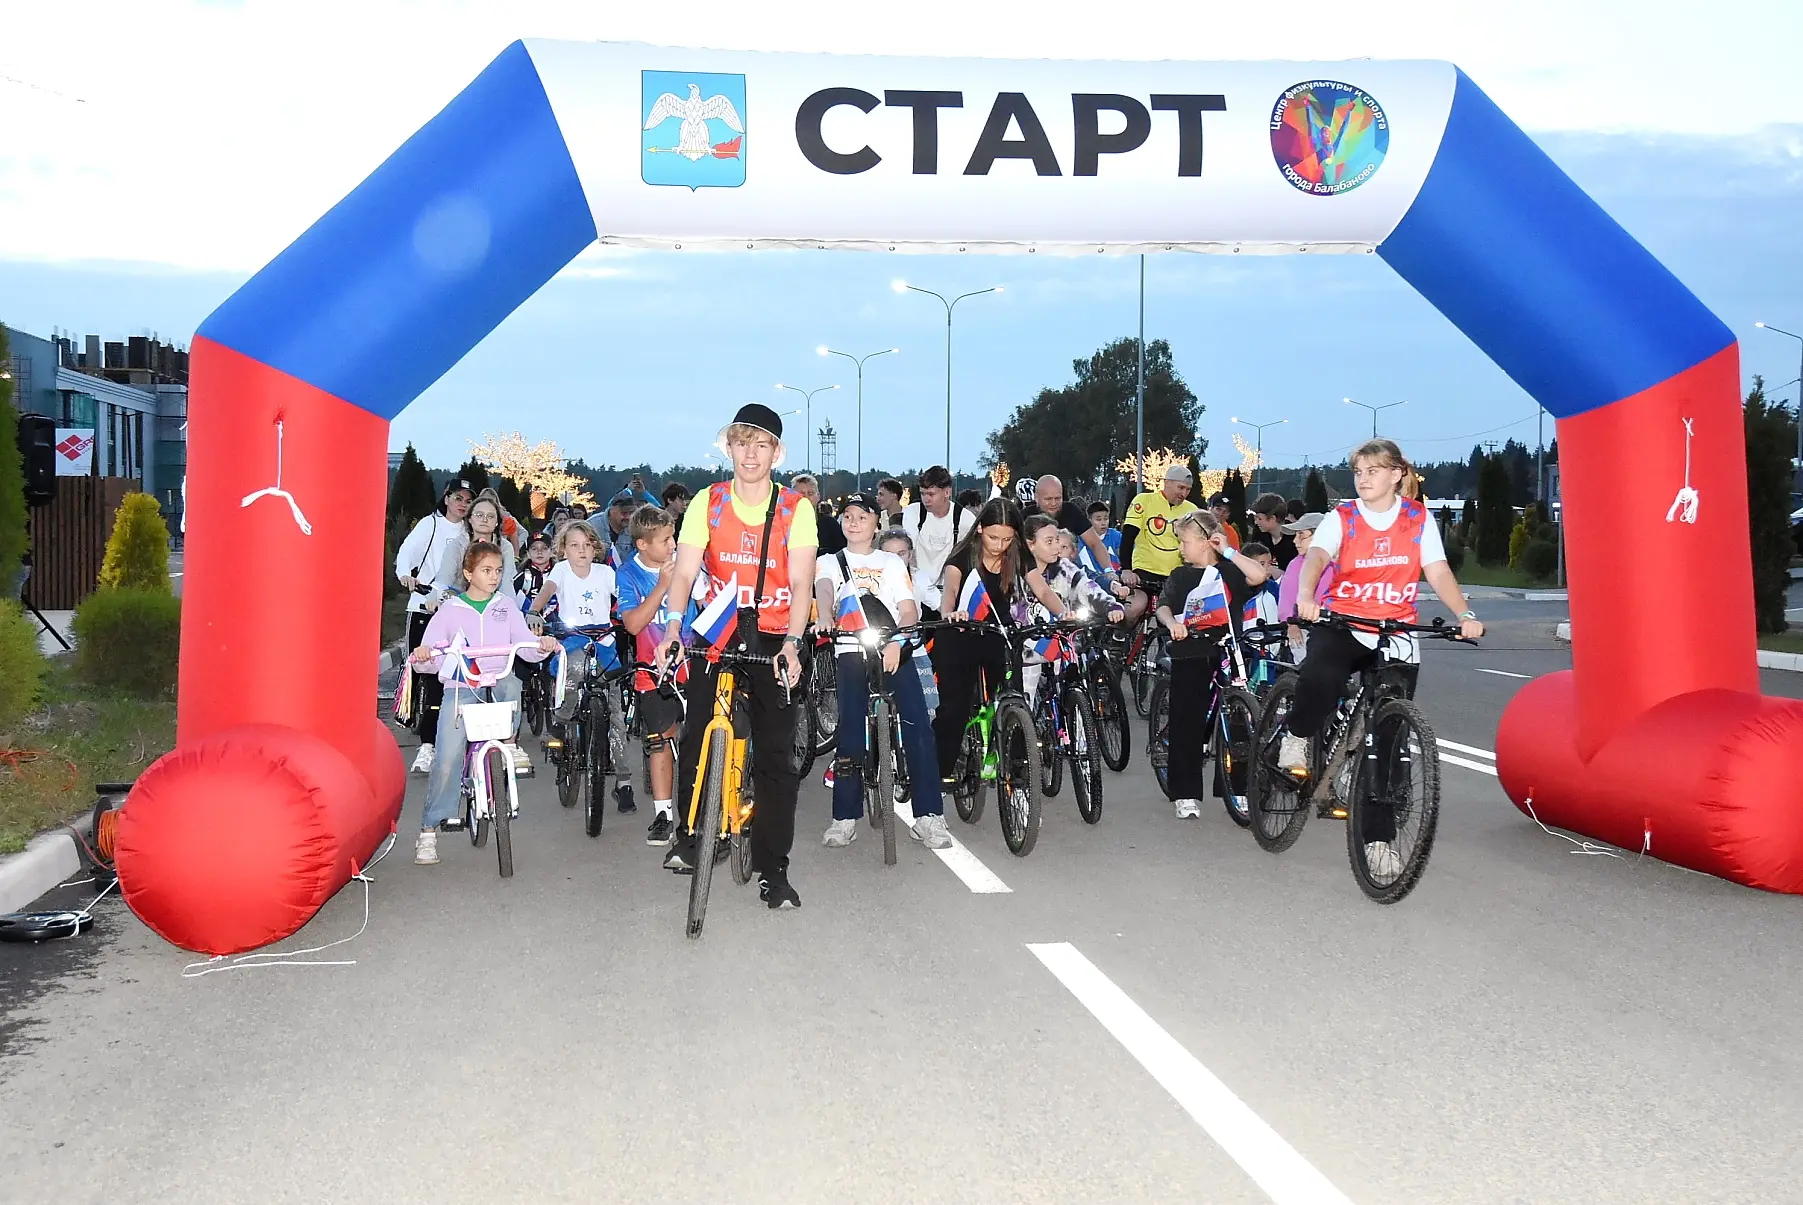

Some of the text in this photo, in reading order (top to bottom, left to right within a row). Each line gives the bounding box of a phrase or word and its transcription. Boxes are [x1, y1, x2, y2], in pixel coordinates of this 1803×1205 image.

[1271, 81, 1387, 130] Центр физкультуры и спорта
[795, 87, 1227, 177] СТАРТ
[1282, 163, 1375, 193] города Балабаново
[1355, 556, 1408, 569] БАЛАБАНОВО
